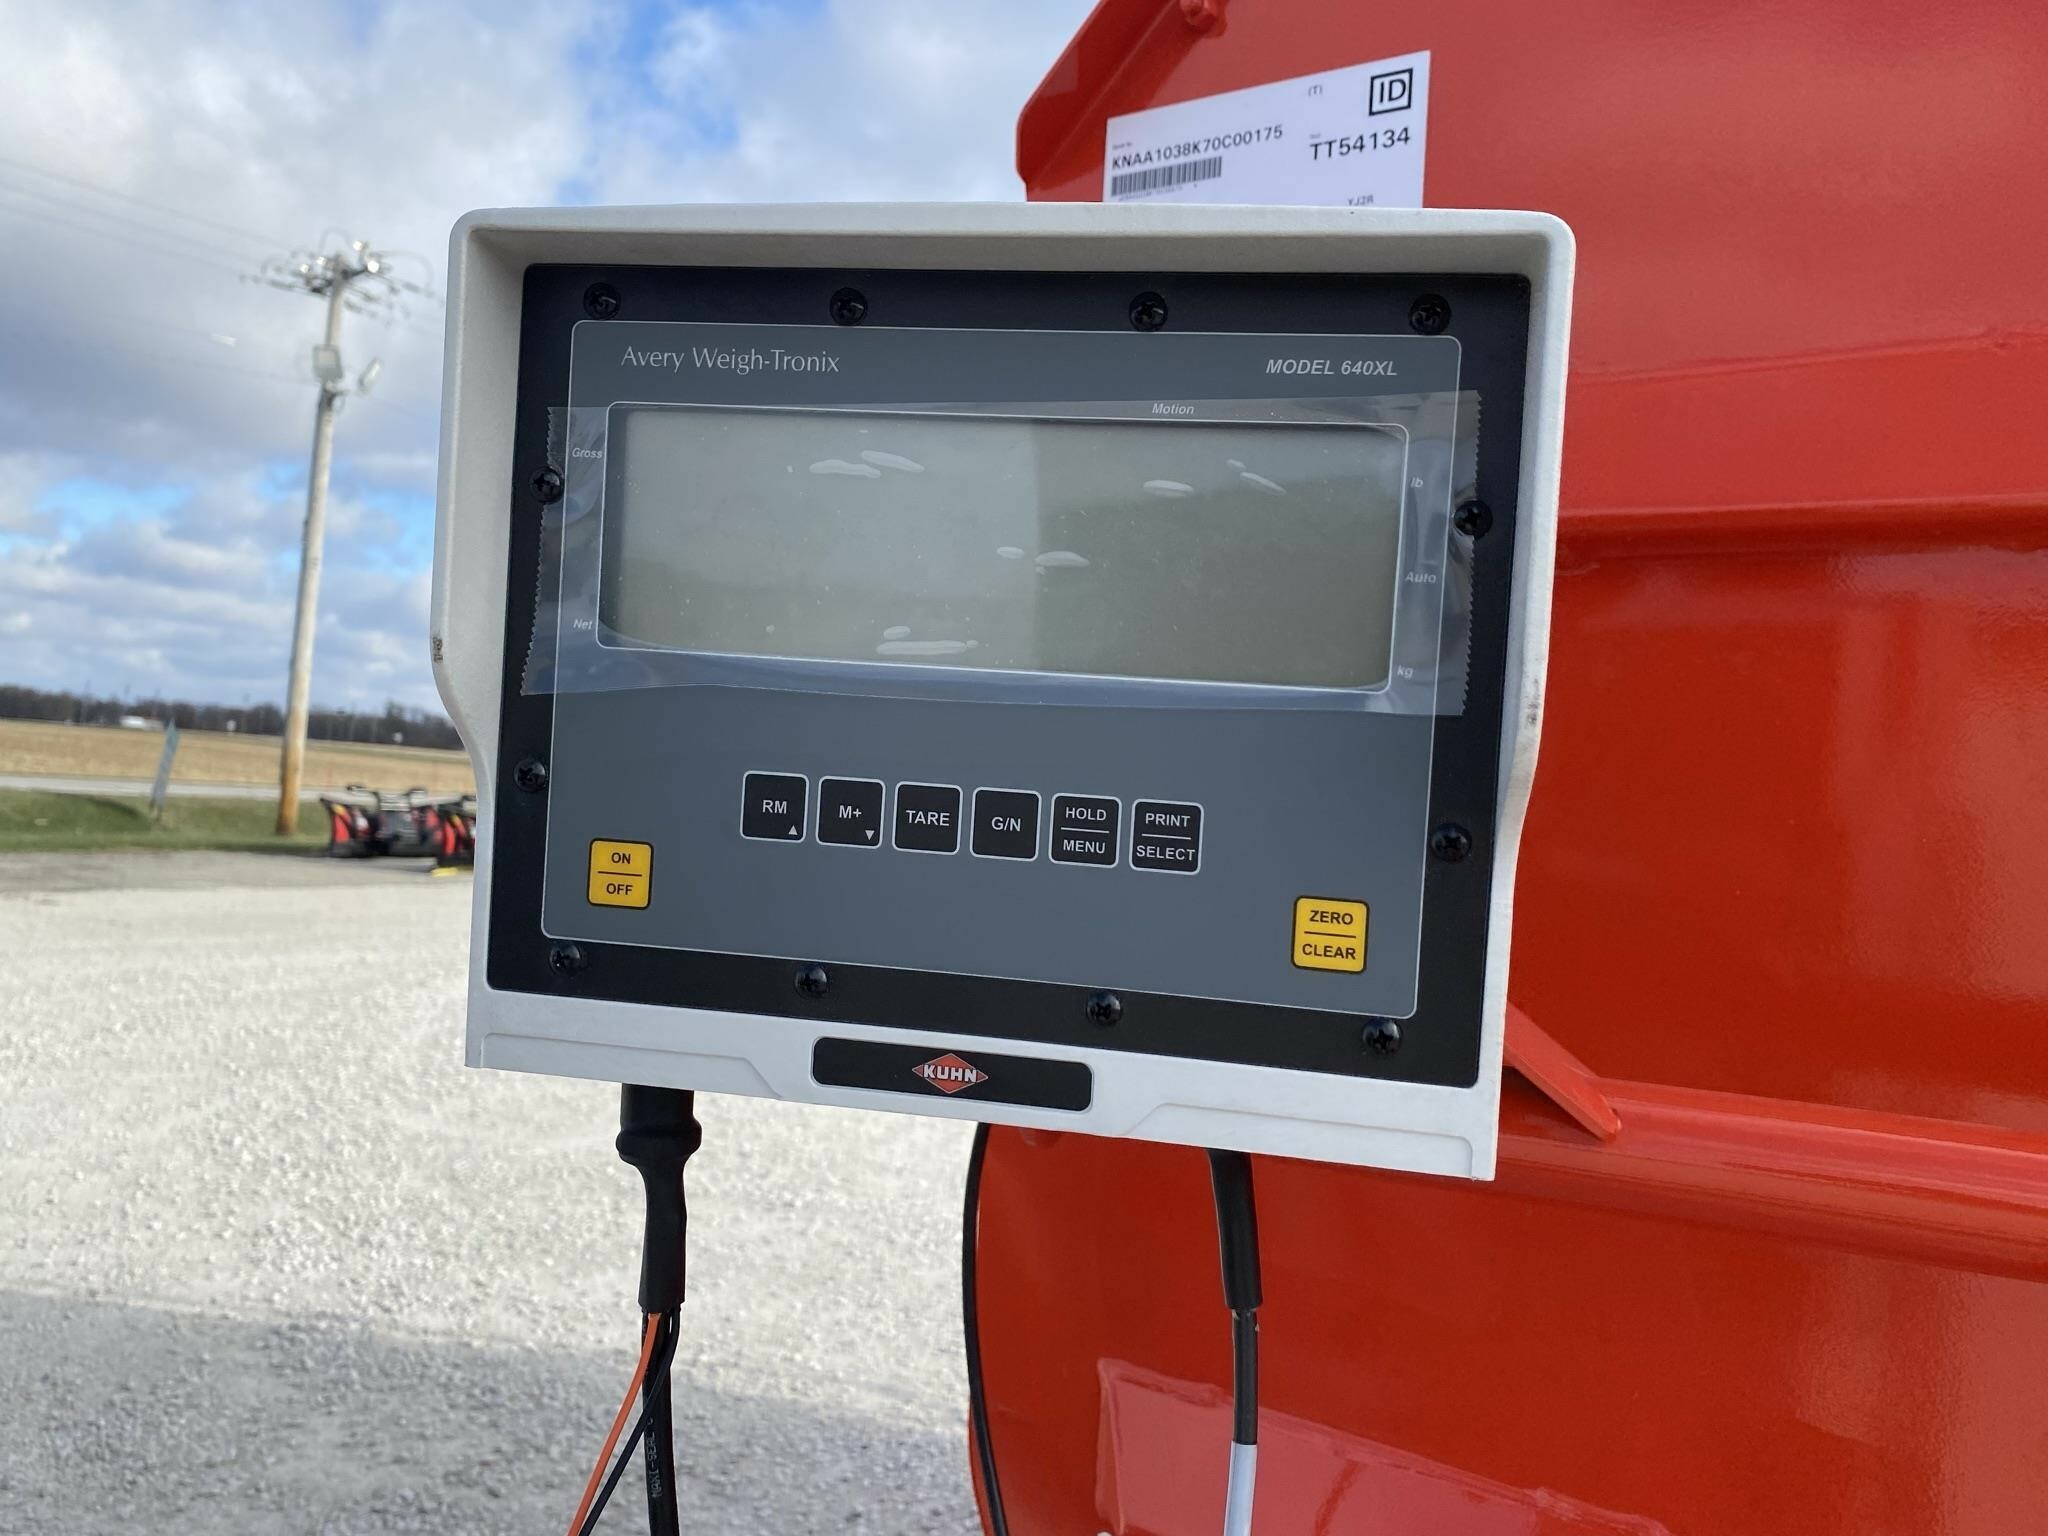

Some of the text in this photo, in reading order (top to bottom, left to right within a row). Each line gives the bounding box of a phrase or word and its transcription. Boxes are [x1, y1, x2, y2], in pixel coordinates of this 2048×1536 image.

[1379, 79, 1407, 104] ID
[1111, 124, 1284, 171] KNAA1038K70C00175
[1310, 126, 1411, 161] TT54134
[620, 345, 840, 376] Avery Weigh-Tronix
[1265, 358, 1398, 376] MODEL 640XL
[1151, 402, 1195, 416] Motion
[571, 447, 603, 460] Gross
[1405, 570, 1437, 584] Auto
[573, 618, 593, 631] Net
[1396, 664, 1415, 679] kg
[762, 799, 788, 815] RM
[838, 804, 863, 820] M+
[1065, 806, 1108, 822] HOLD
[905, 809, 951, 827] TARE
[990, 815, 1022, 833] G/N
[1144, 812, 1191, 828] PRINT
[1062, 838, 1106, 855] MENU
[1135, 844, 1196, 861] SELECT
[611, 851, 632, 865] ON
[605, 882, 634, 896] OFF
[1308, 909, 1355, 926] ZERO
[1301, 942, 1357, 961] CLEAR
[922, 1064, 978, 1083] KUHN
